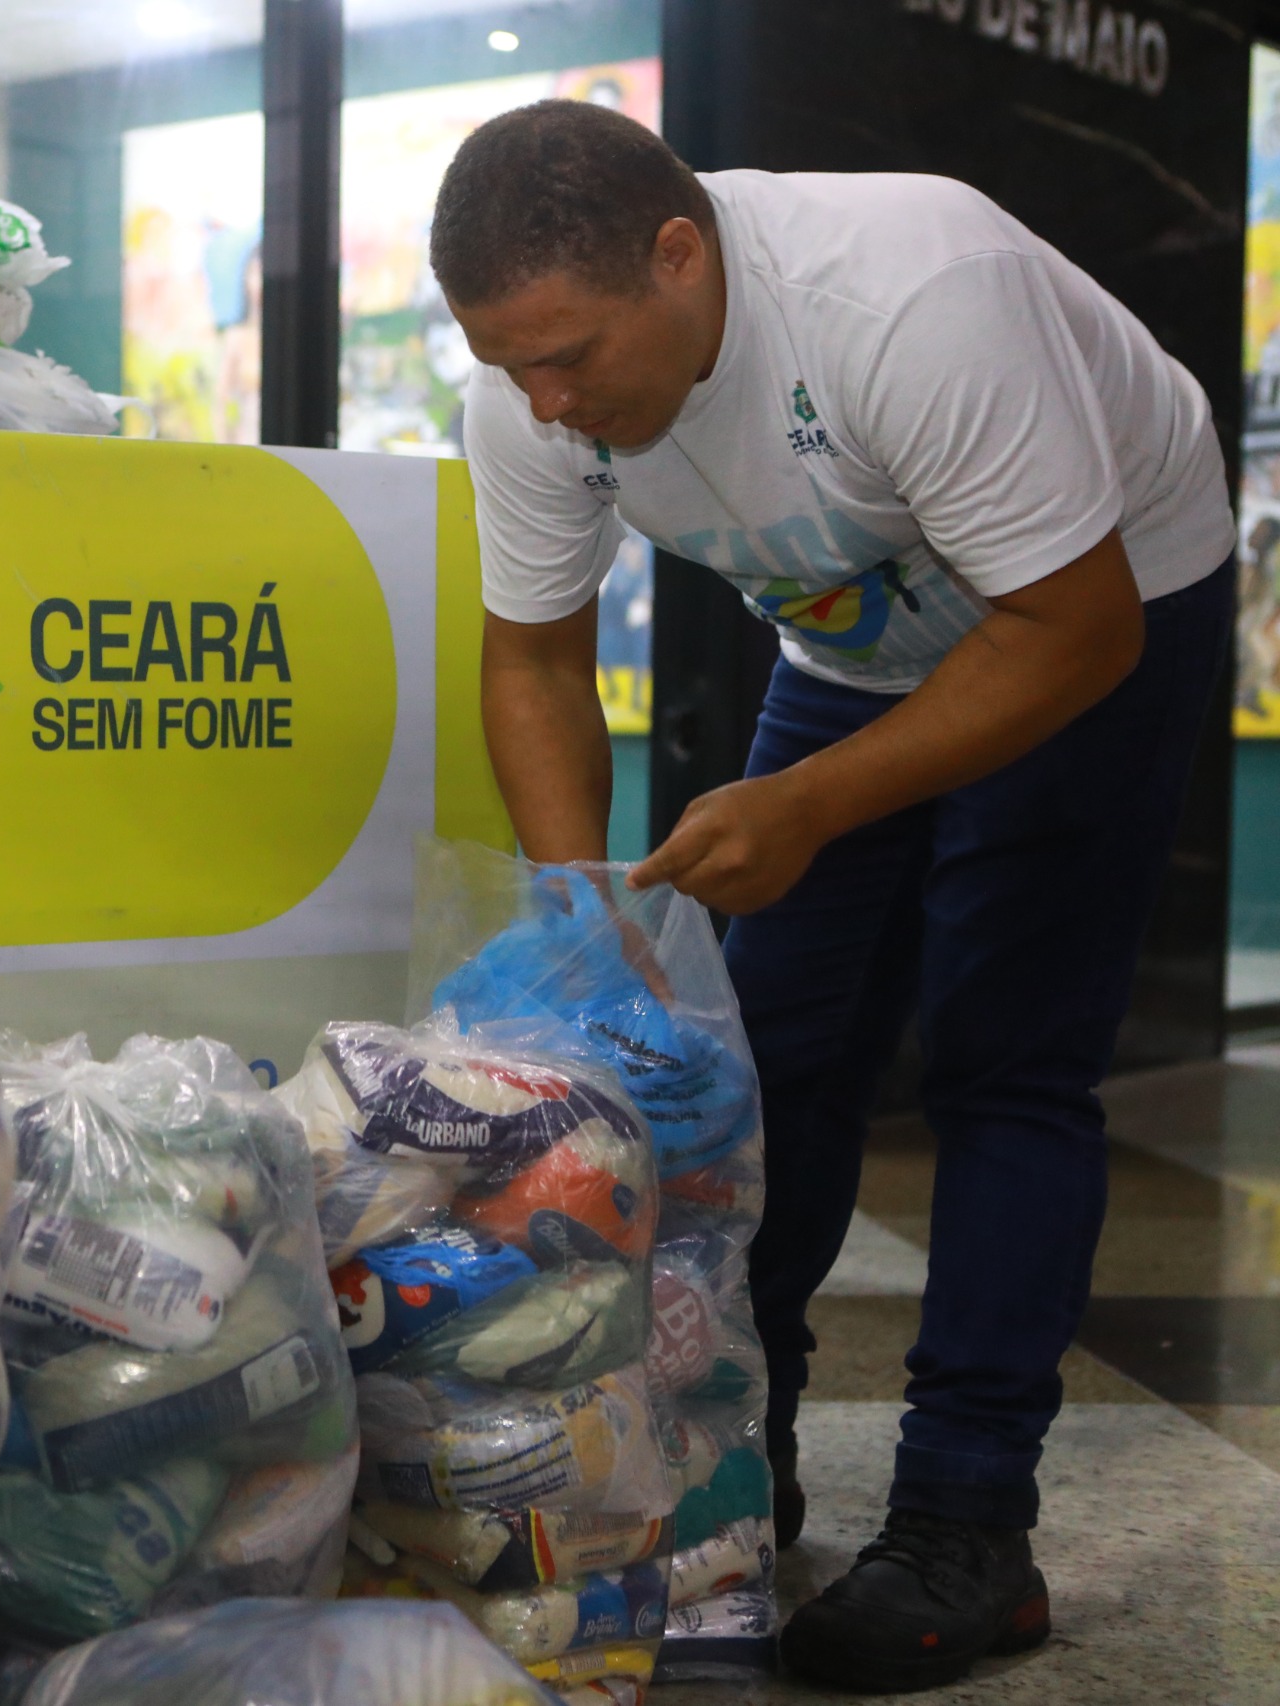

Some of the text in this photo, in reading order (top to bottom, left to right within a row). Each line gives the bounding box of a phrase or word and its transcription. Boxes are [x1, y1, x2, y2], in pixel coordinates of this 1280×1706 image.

[1048, 0, 1169, 97] MAIO
[30, 582, 292, 684] CEARÁ
[32, 697, 292, 751] SEM FOME
[418, 1119, 491, 1147] URBANO
